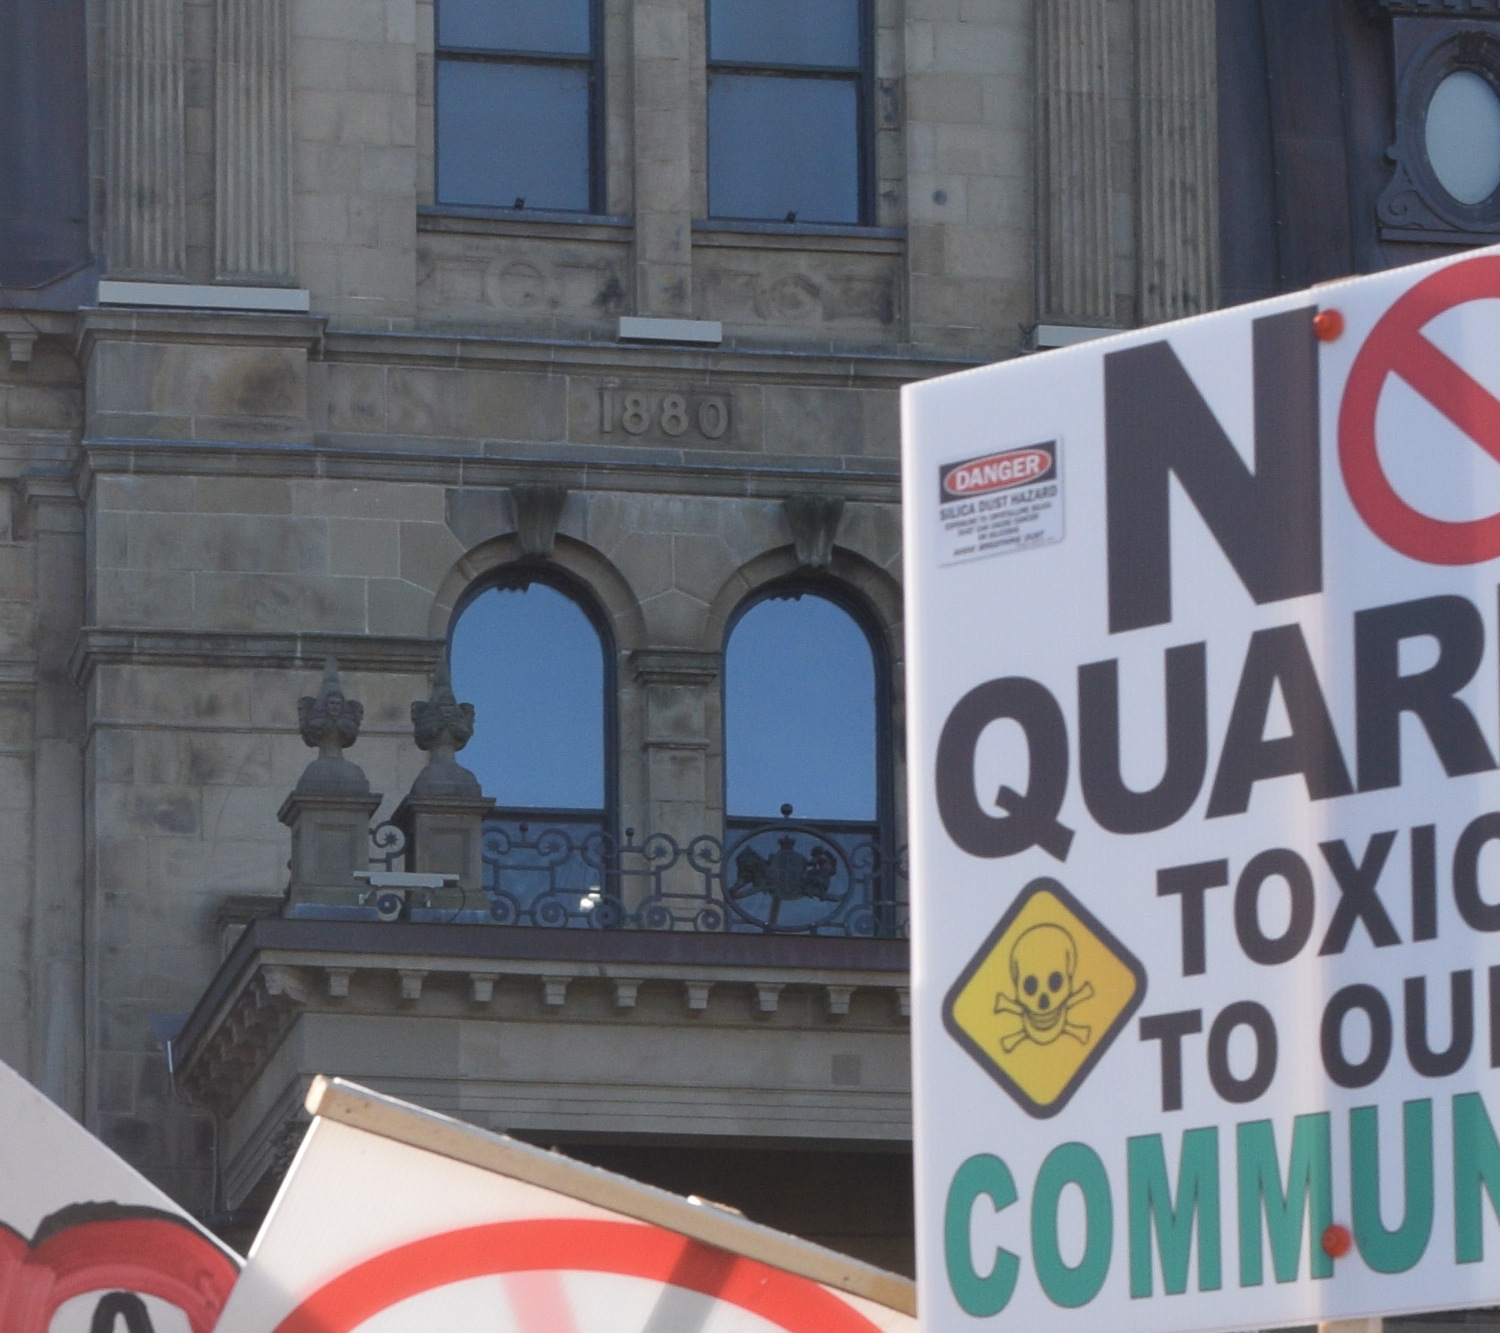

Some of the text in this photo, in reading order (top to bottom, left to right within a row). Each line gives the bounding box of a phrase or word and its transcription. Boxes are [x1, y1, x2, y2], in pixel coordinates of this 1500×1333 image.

[603, 391, 728, 438] 1880
[955, 455, 1040, 490] DANGER
[1139, 1000, 1279, 1112] TO
